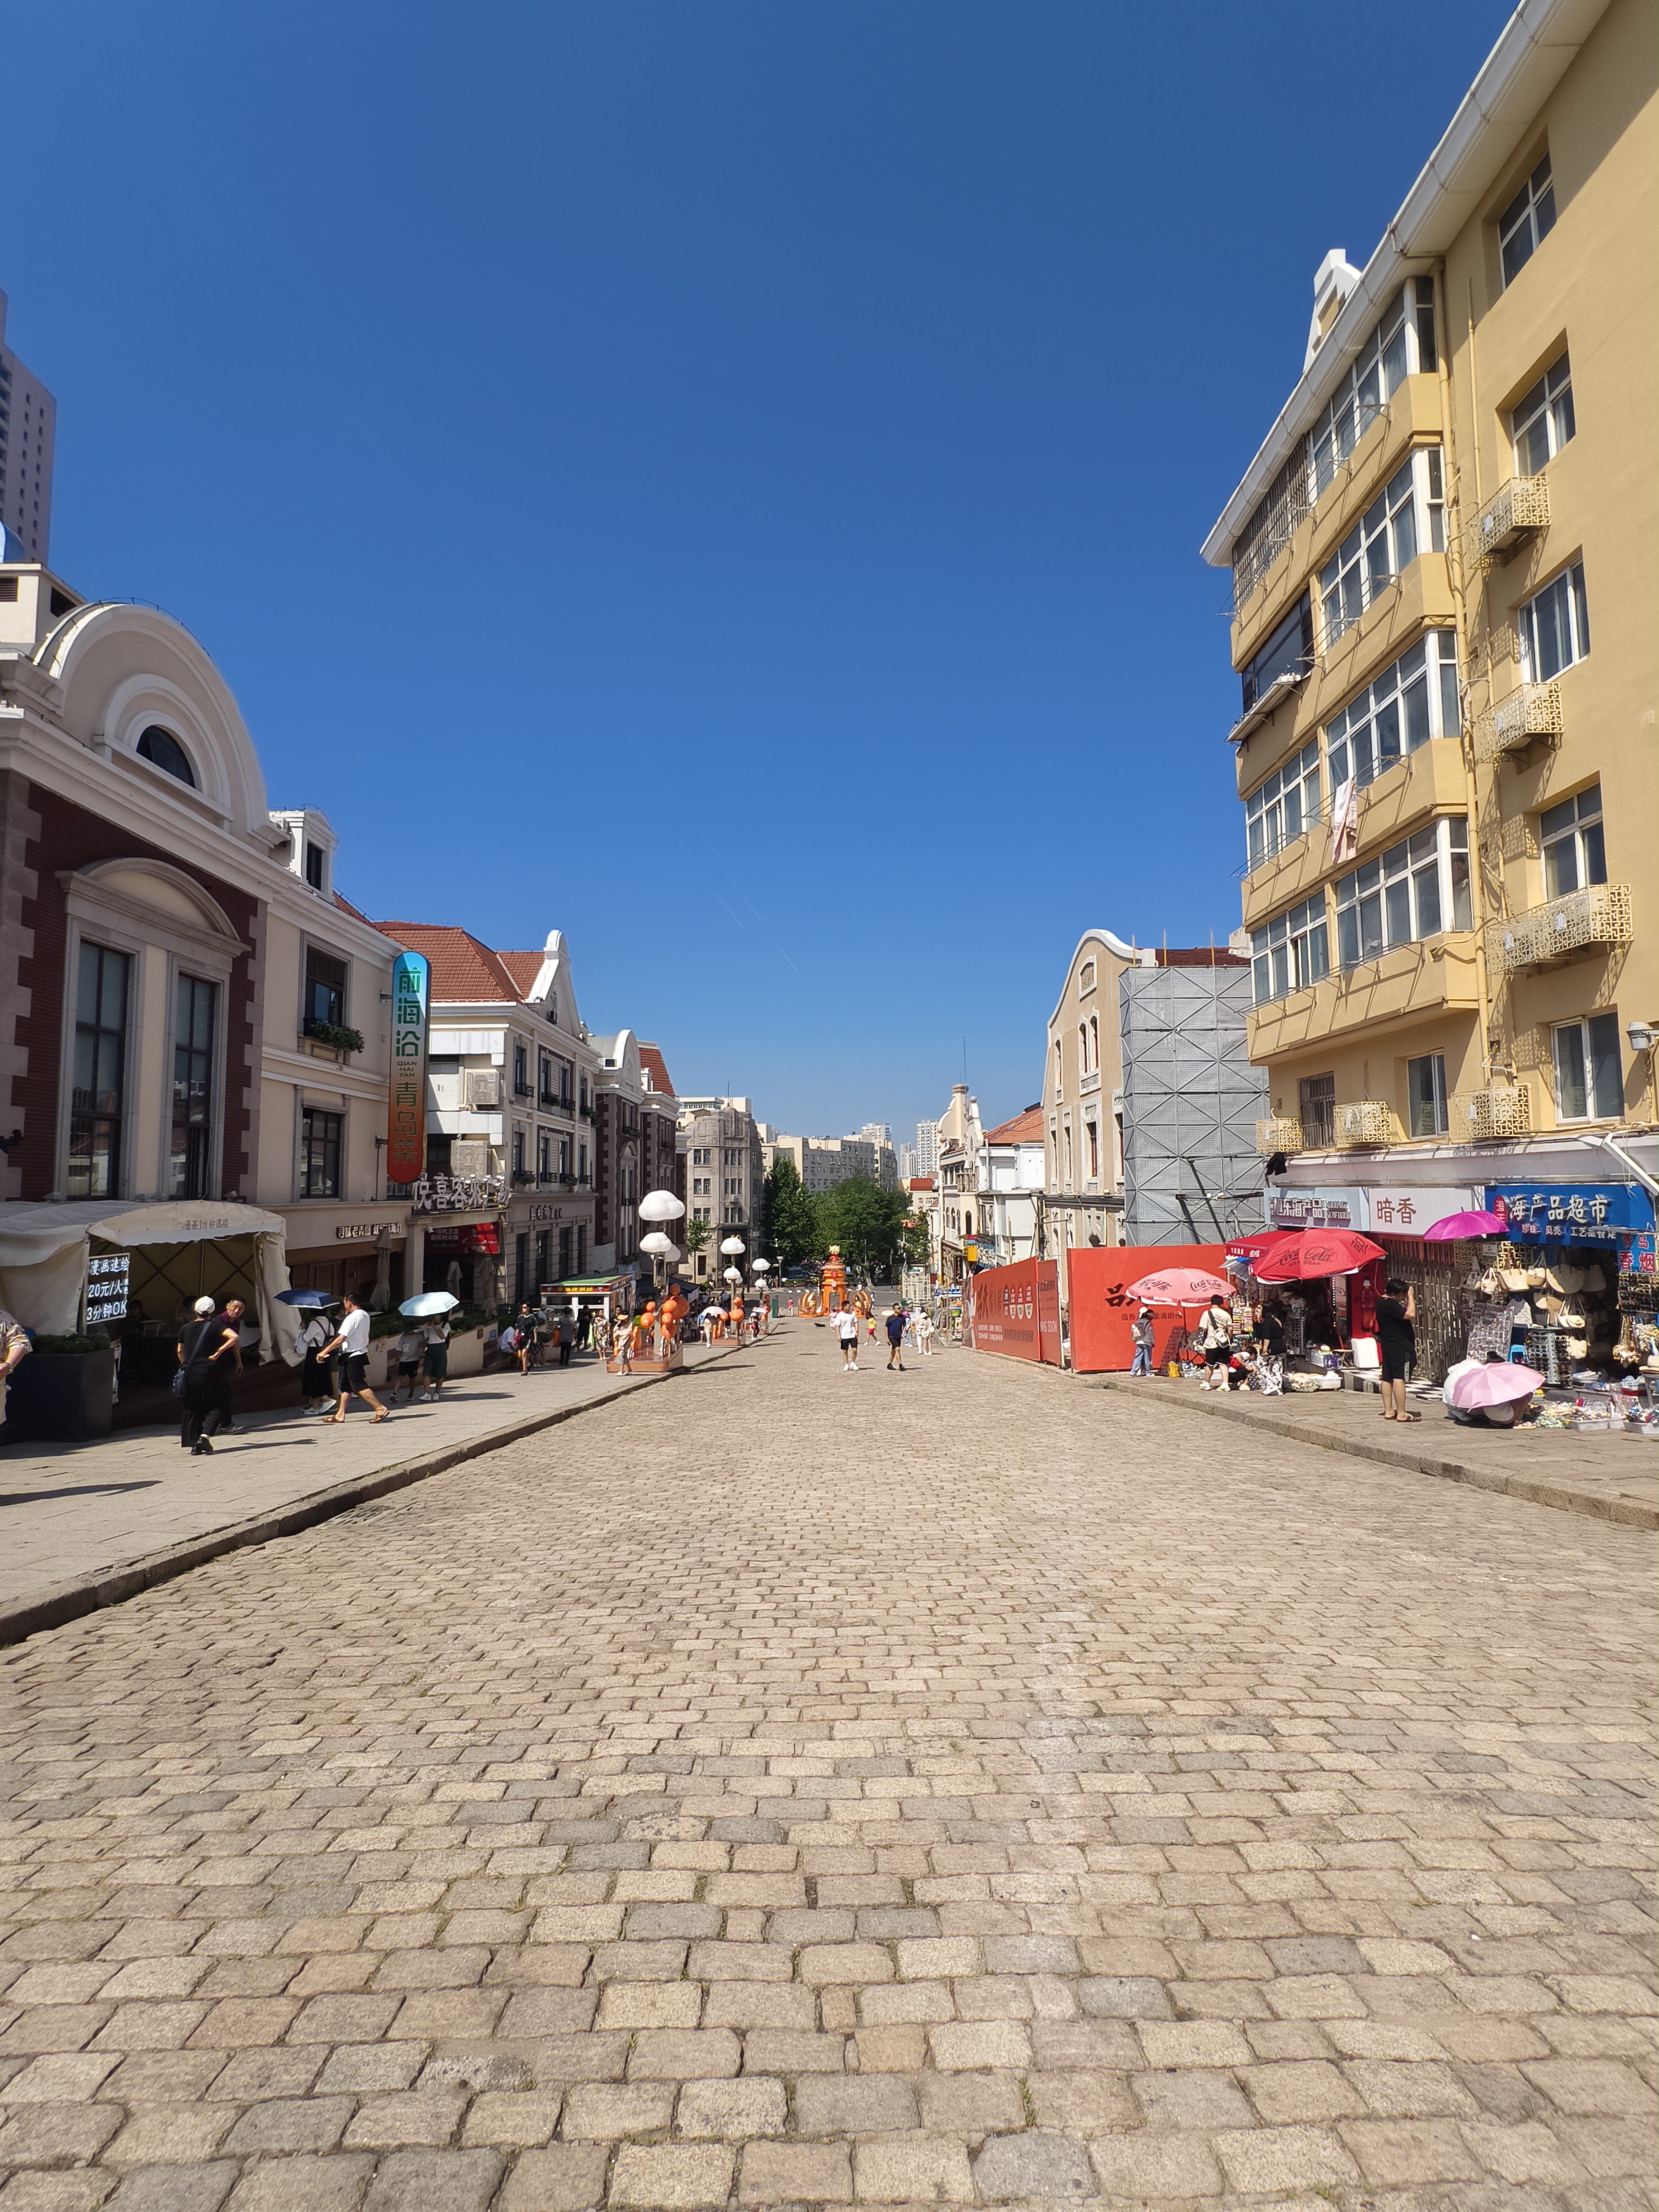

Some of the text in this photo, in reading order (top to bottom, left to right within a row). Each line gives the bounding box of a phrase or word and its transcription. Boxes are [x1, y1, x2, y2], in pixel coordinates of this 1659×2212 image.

[396, 967, 421, 1057] 前海沿
[393, 1082, 419, 1164] 青岛菜
[1377, 1197, 1417, 1224] 暗香
[1509, 1194, 1608, 1225] 海产品超市
[1521, 1224, 1537, 1233] 珍珠
[1546, 1225, 1561, 1235] 贝壳
[1622, 1233, 1649, 1249] 青岛
[90, 1257, 130, 1276] 漫画速绘
[1618, 1250, 1656, 1273] 香烟
[86, 1300, 127, 1321] 3分钟OK
